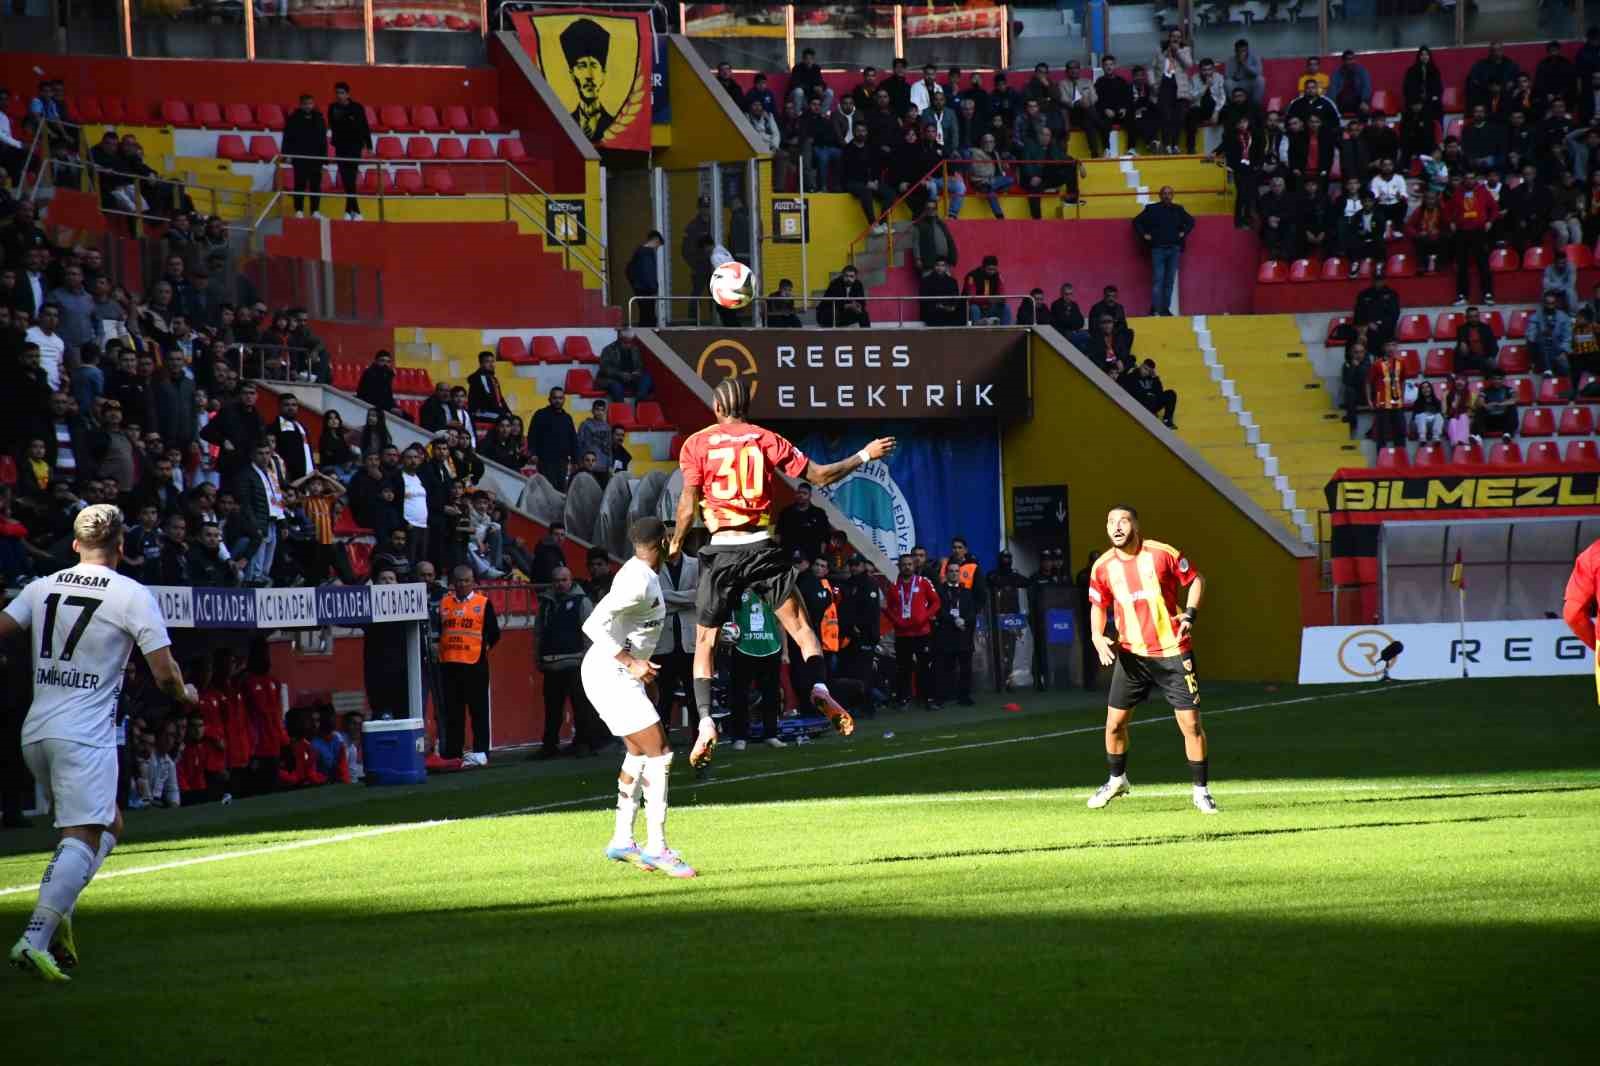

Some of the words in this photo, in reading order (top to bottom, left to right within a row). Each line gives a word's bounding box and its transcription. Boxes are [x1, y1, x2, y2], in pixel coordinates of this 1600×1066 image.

[777, 345, 910, 368] REGES
[778, 379, 994, 407] ELEKTRİK
[707, 445, 764, 500] 30
[195, 593, 256, 622] ACIBADEM
[260, 594, 315, 621] ACIBADEM
[318, 591, 371, 619] ACIBADEM
[374, 588, 425, 616] ACIBADEM
[40, 593, 104, 661] 17
[1449, 636, 1587, 664] REG
